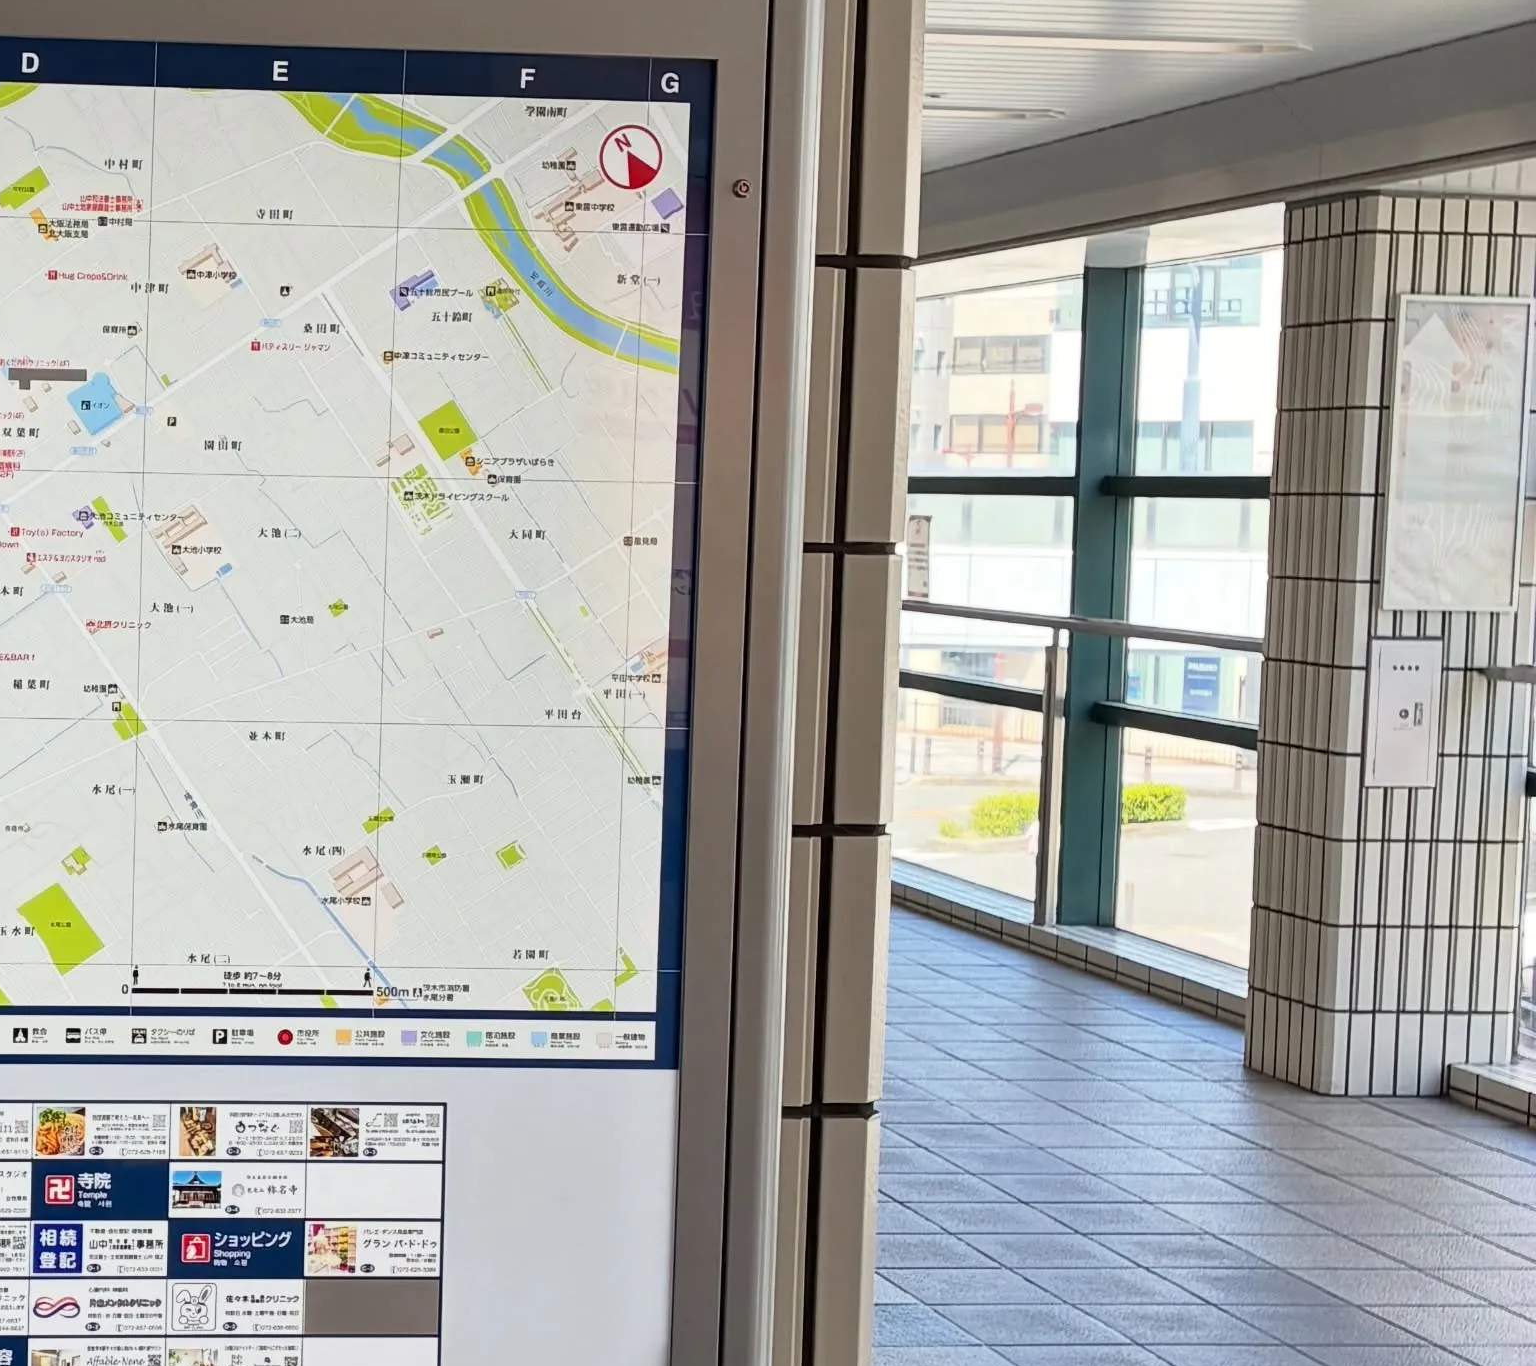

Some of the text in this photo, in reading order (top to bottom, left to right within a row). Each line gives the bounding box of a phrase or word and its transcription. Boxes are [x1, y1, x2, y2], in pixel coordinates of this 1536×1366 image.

[21, 53, 39, 73] D
[273, 61, 288, 81] E
[521, 68, 535, 89] F
[661, 73, 679, 94] G
[614, 134, 632, 152] N
[377, 987, 410, 997] 500m
[78, 1173, 111, 1190] 寺院
[78, 1191, 108, 1200] Temple
[40, 1228, 77, 1246] 相続
[214, 1231, 292, 1248] ショッピング
[40, 1251, 76, 1269] 登記
[214, 1250, 251, 1259] Shopping
